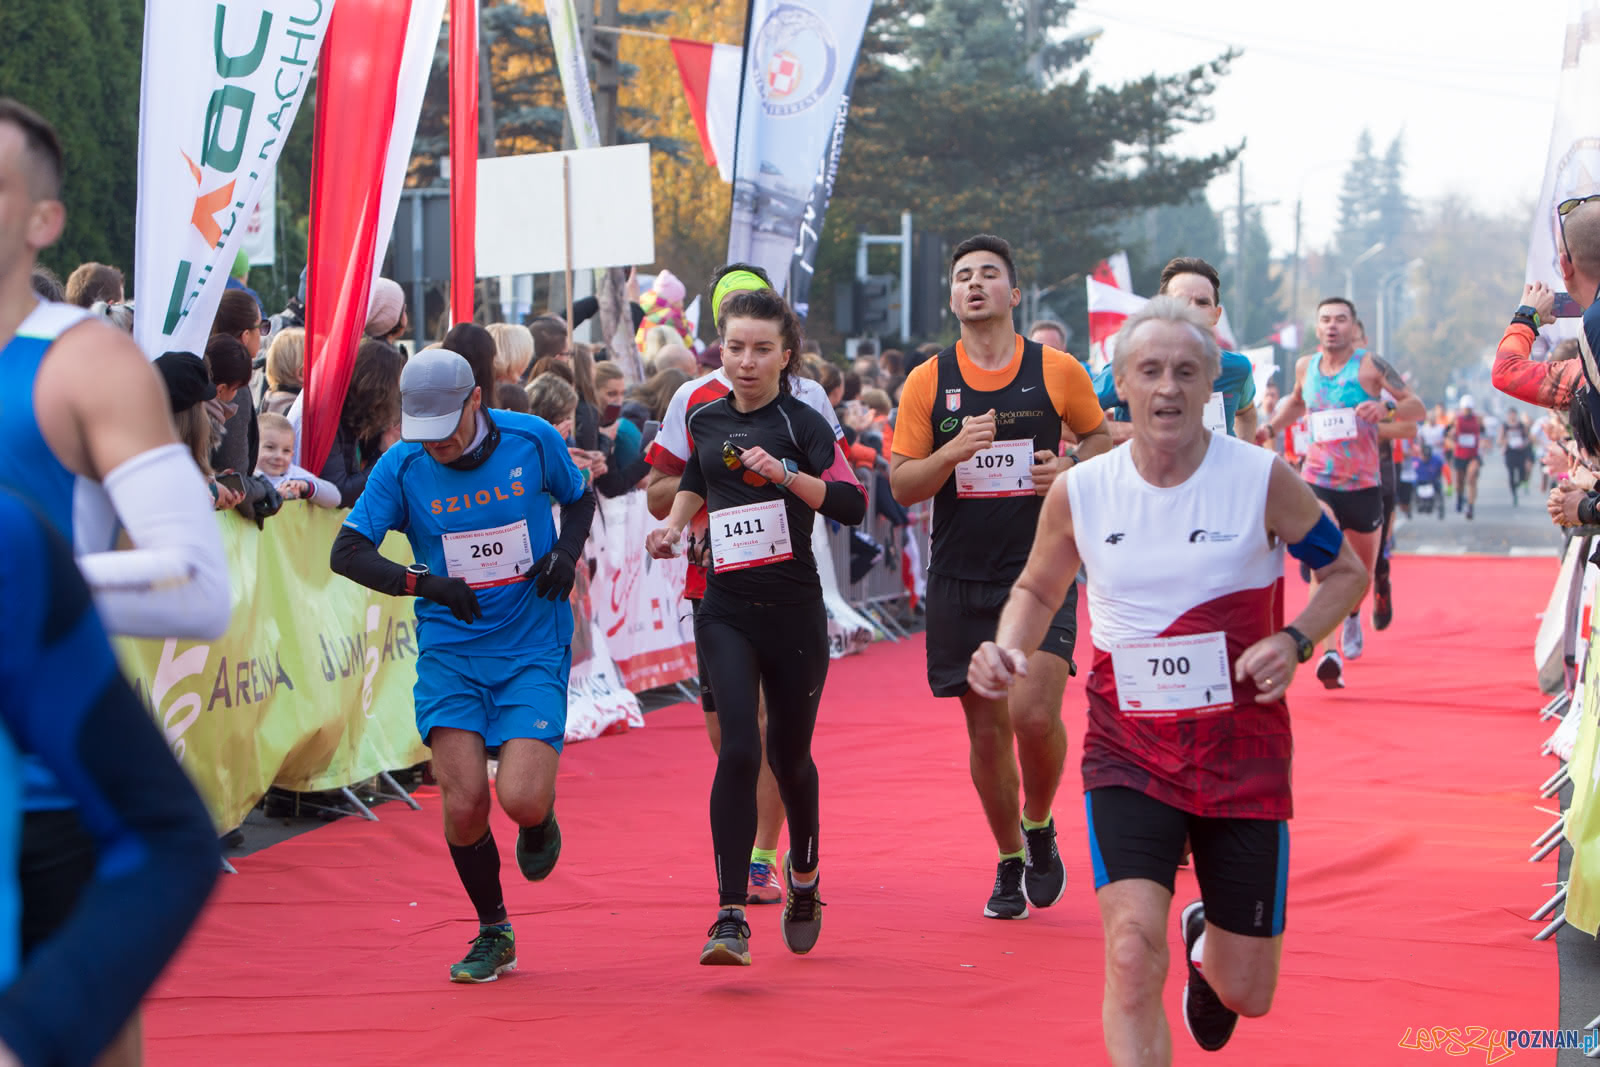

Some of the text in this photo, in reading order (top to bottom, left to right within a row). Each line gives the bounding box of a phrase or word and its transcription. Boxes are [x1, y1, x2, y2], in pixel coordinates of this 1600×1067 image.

[975, 454, 1014, 469] 1079
[430, 481, 525, 515] SZIOLS
[723, 518, 765, 538] 1411
[470, 541, 503, 558] 260
[1147, 656, 1191, 677] 700
